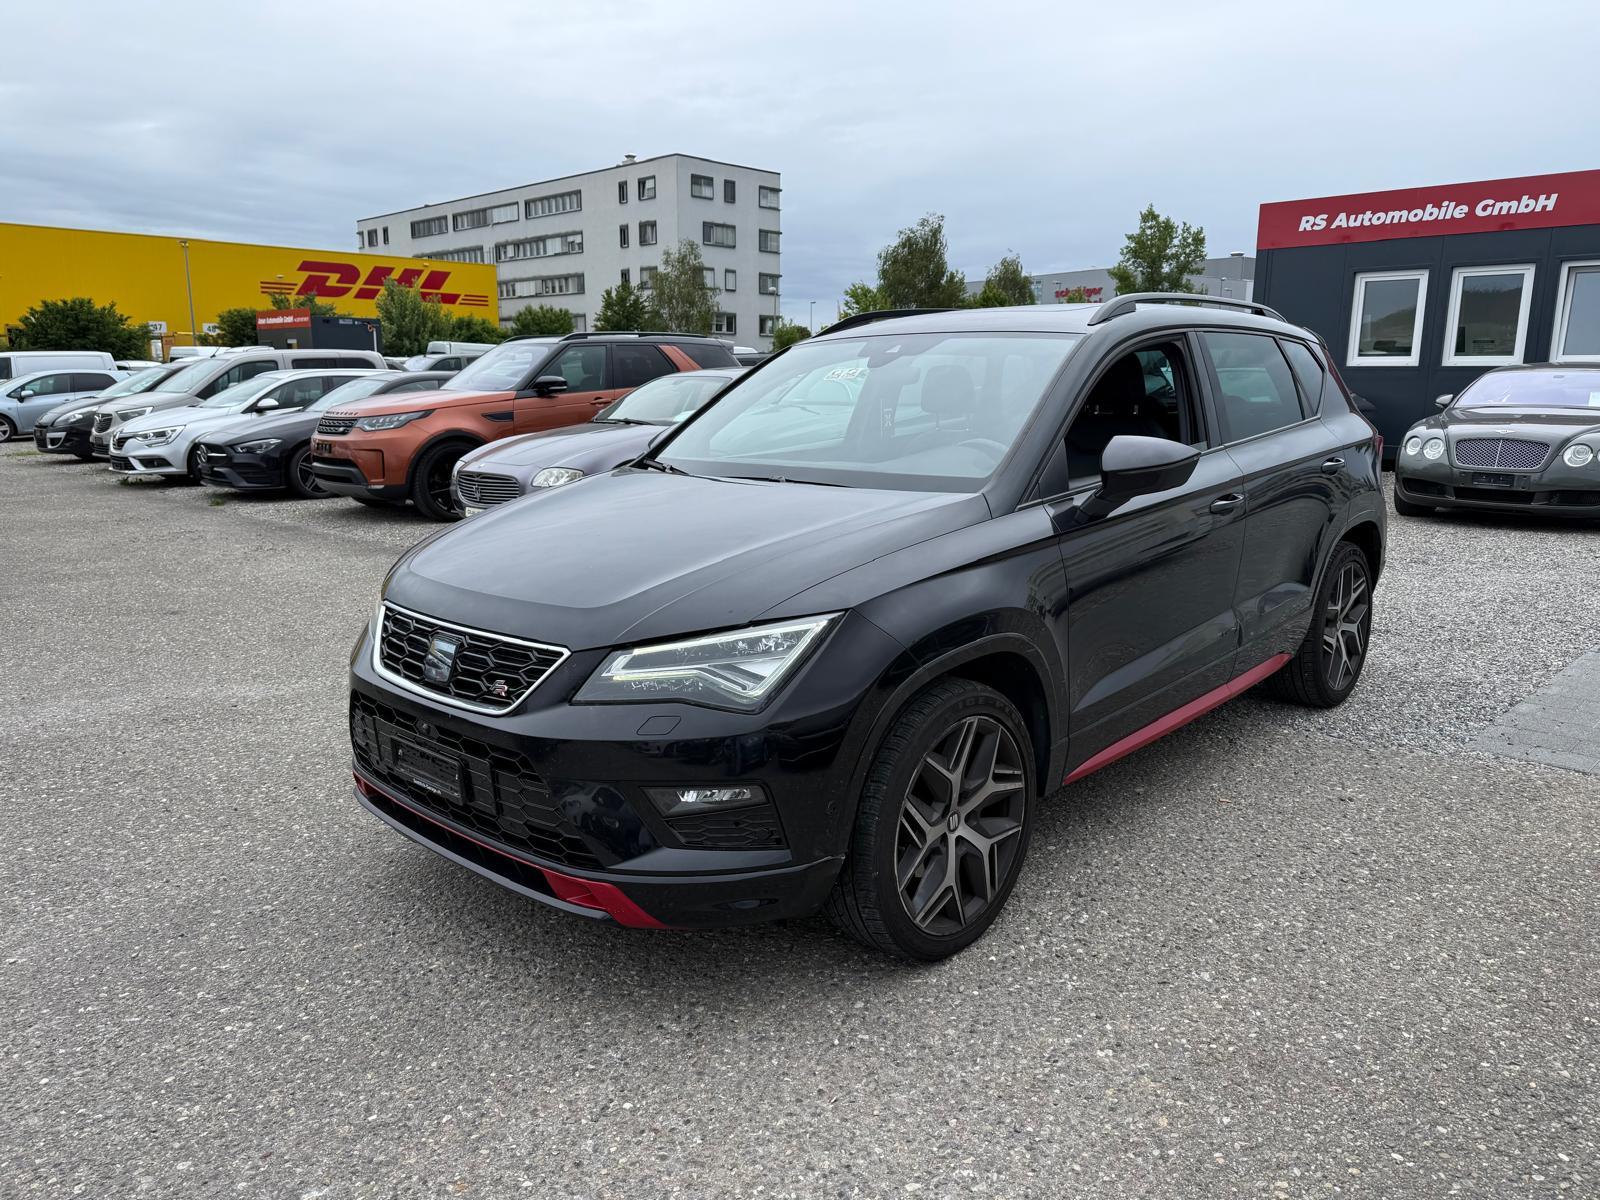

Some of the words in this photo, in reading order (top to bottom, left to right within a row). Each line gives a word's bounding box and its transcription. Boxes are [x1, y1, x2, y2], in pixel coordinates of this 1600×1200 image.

[1298, 213, 1328, 231] RS
[1330, 200, 1469, 230] Automobile
[1474, 193, 1559, 217] GmbH
[295, 260, 462, 305] DHL
